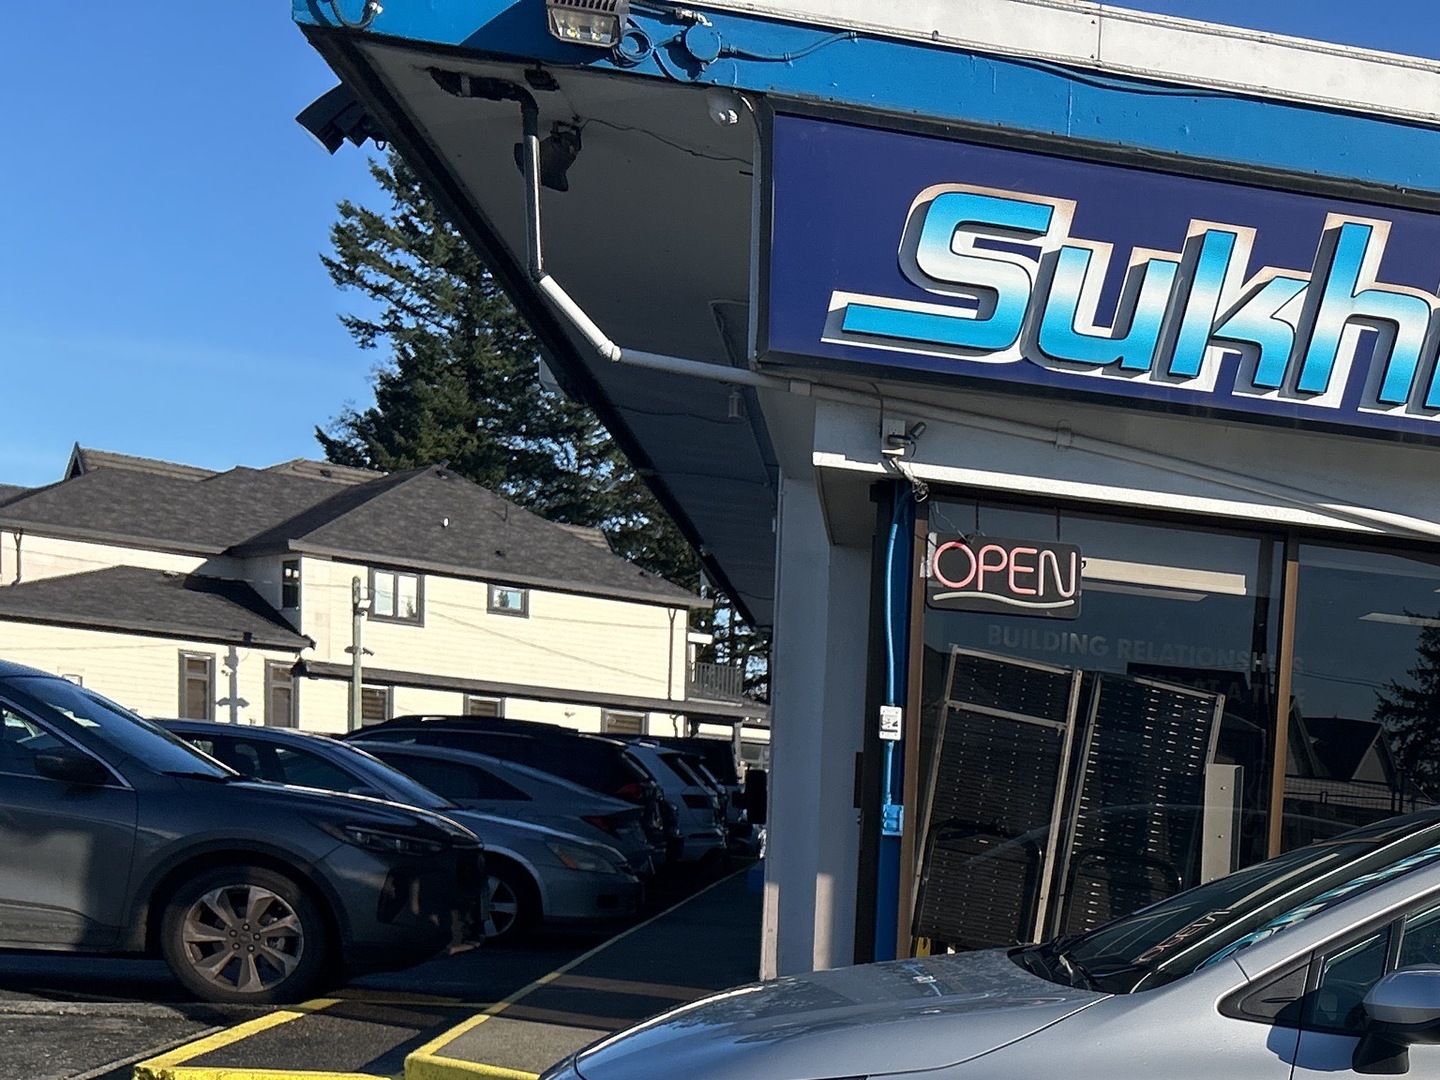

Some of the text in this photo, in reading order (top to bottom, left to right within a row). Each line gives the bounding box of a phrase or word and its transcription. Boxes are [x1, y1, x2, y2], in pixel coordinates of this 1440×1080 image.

[932, 541, 1077, 598] OPEN
[988, 624, 1304, 675] BUILDING RELATIONSHIS
